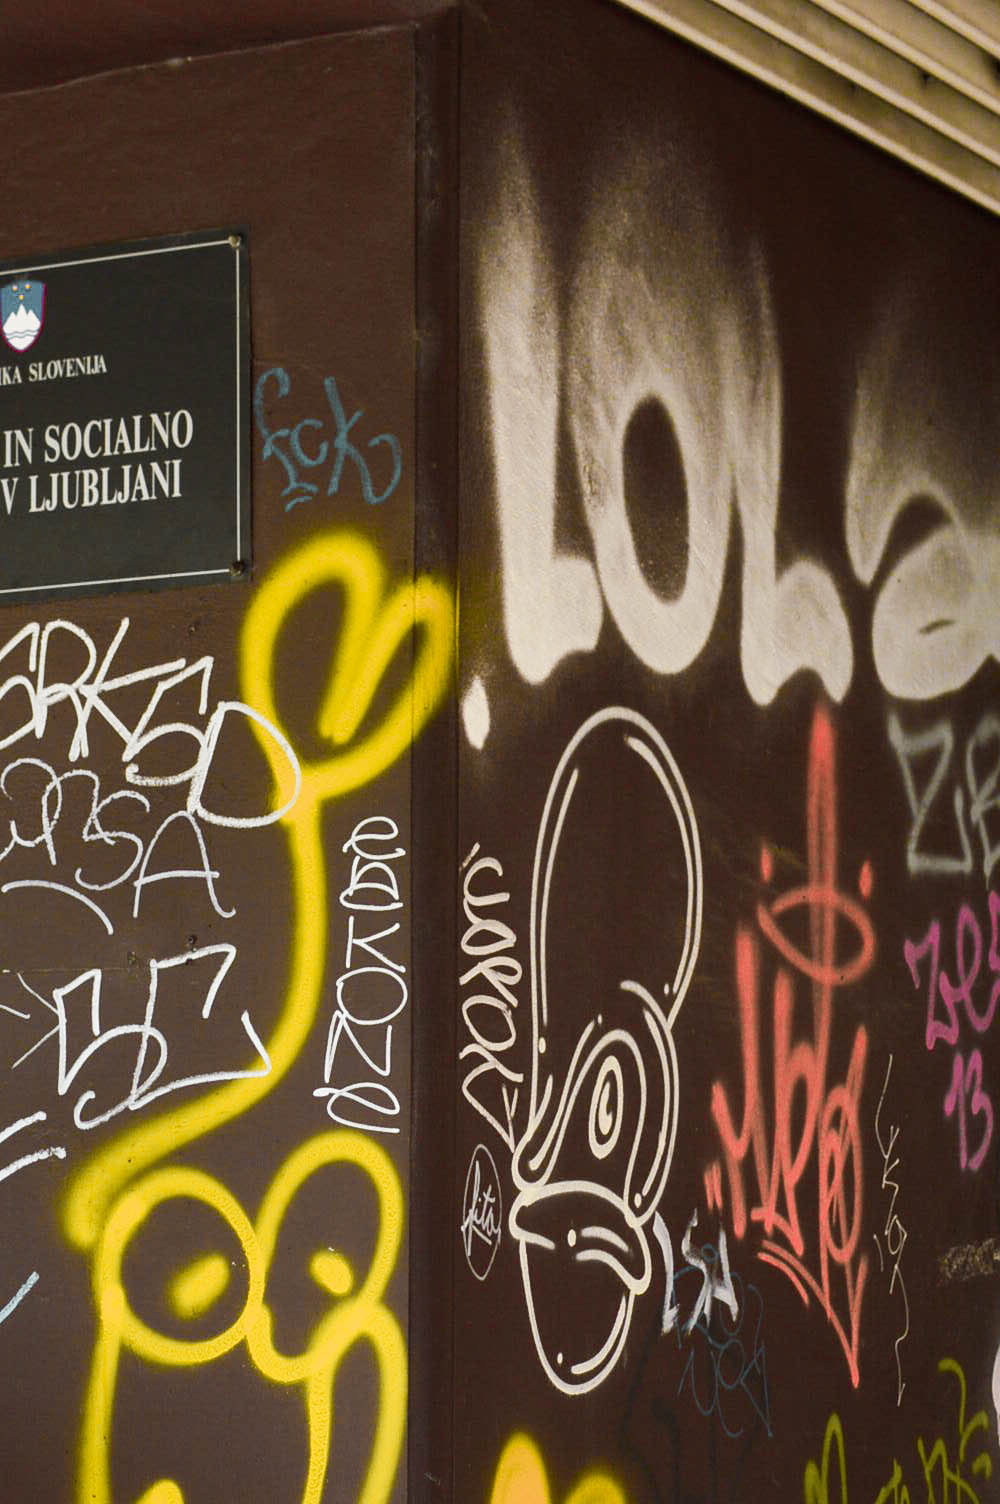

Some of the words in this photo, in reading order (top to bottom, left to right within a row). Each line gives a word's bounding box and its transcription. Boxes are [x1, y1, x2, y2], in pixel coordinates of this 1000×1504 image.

[28, 354, 107, 382] SLOVENIJA
[3, 428, 34, 468] IN
[44, 409, 193, 463] SOCIALNO
[0, 477, 18, 515] V
[29, 459, 182, 513] LJUBLJANI
